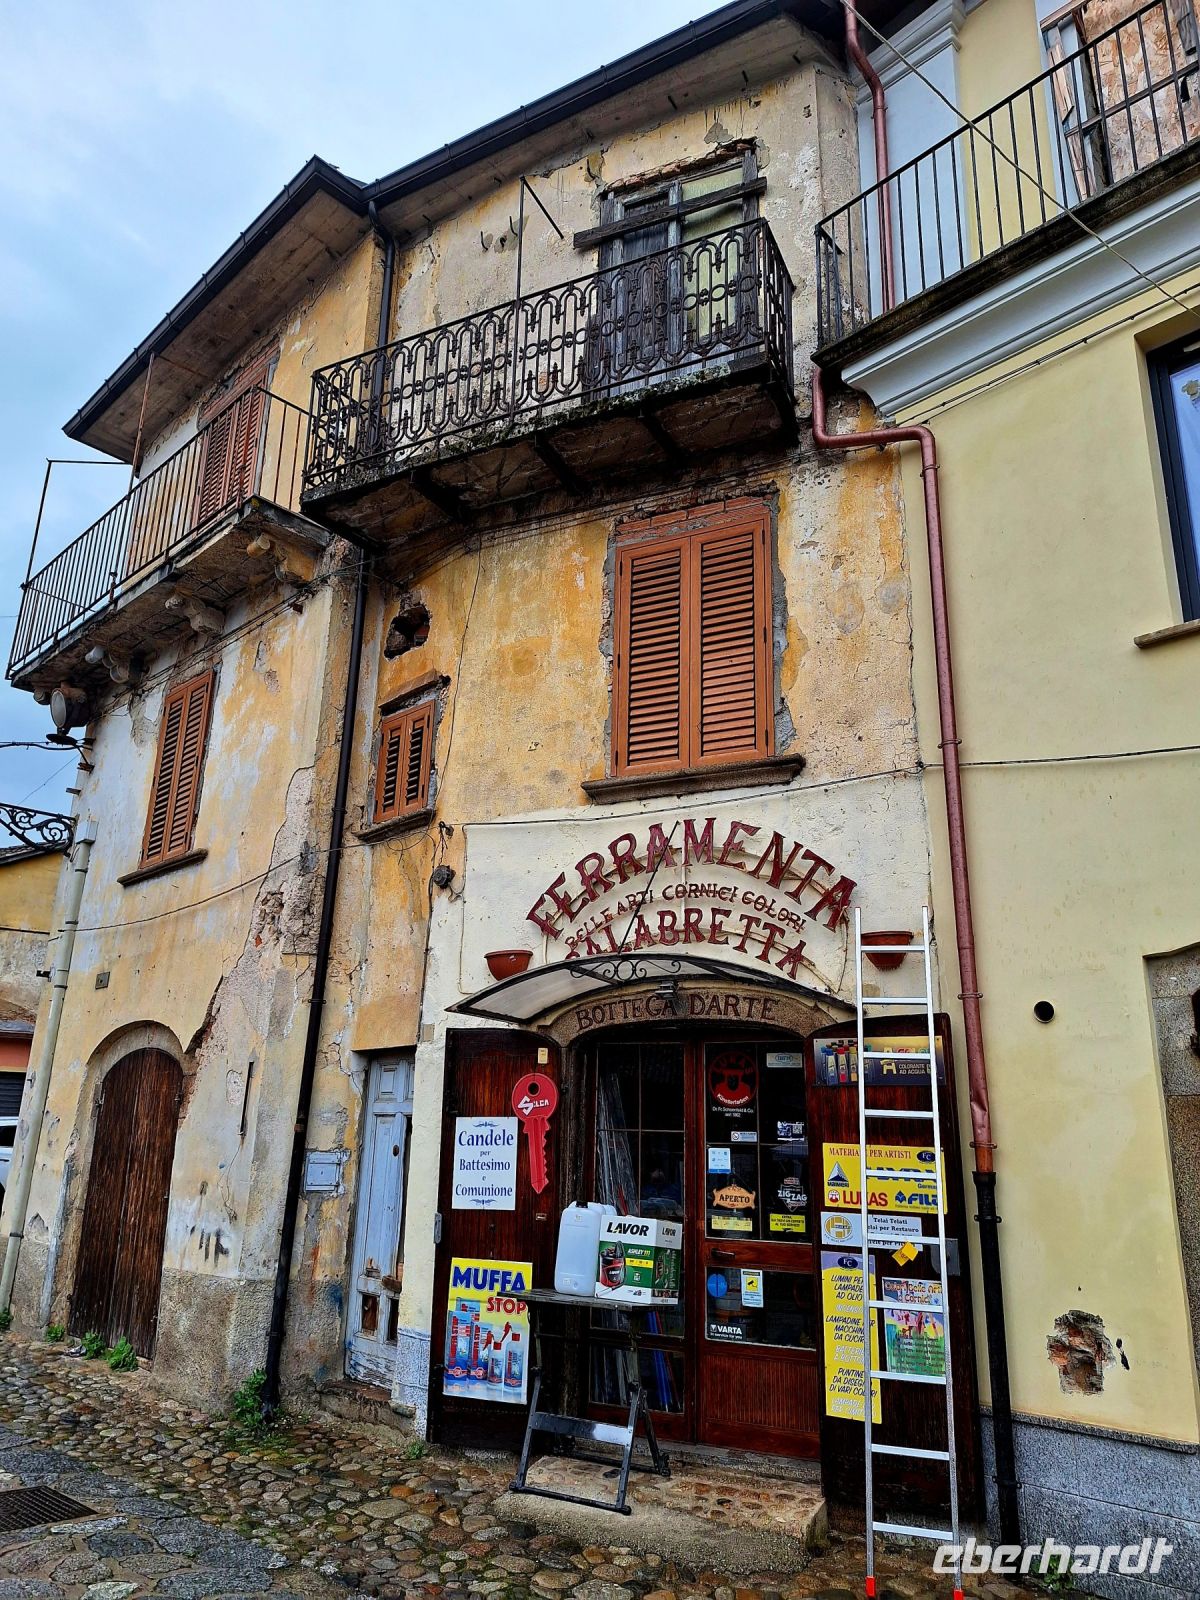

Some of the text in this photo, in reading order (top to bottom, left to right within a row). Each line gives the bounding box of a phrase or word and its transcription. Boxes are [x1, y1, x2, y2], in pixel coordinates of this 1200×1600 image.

[526, 817, 857, 939] FERRAMENTA
[564, 883, 806, 950] BELLE ARTI CORNICI COLORI
[575, 994, 677, 1031] BOTTEGA
[517, 1095, 550, 1116] SILCA
[458, 1129, 514, 1147] Candele
[479, 1150, 492, 1158] per
[869, 1150, 883, 1158] PER
[884, 1151, 911, 1159] ARTISTI
[459, 1158, 511, 1172] Battesimo
[455, 1183, 513, 1197] Comunione
[777, 1190, 791, 1198] ZIG
[719, 1193, 750, 1203] APERTO
[606, 1221, 650, 1237] LAVOR
[662, 1227, 677, 1237] LAVOR
[891, 1225, 919, 1233] Restauro
[452, 1266, 526, 1292] MUFFA
[831, 1274, 852, 1282] LUMINI
[834, 1283, 864, 1293] LAMPADE
[487, 1297, 527, 1315] STOP
[825, 1315, 860, 1326] LAMPADINE
[717, 1325, 742, 1335] VARTA
[834, 1324, 865, 1335] MACCHIN
[834, 1332, 844, 1340] DA
[829, 1384, 837, 1392] DI
[838, 1385, 852, 1394] VARI
